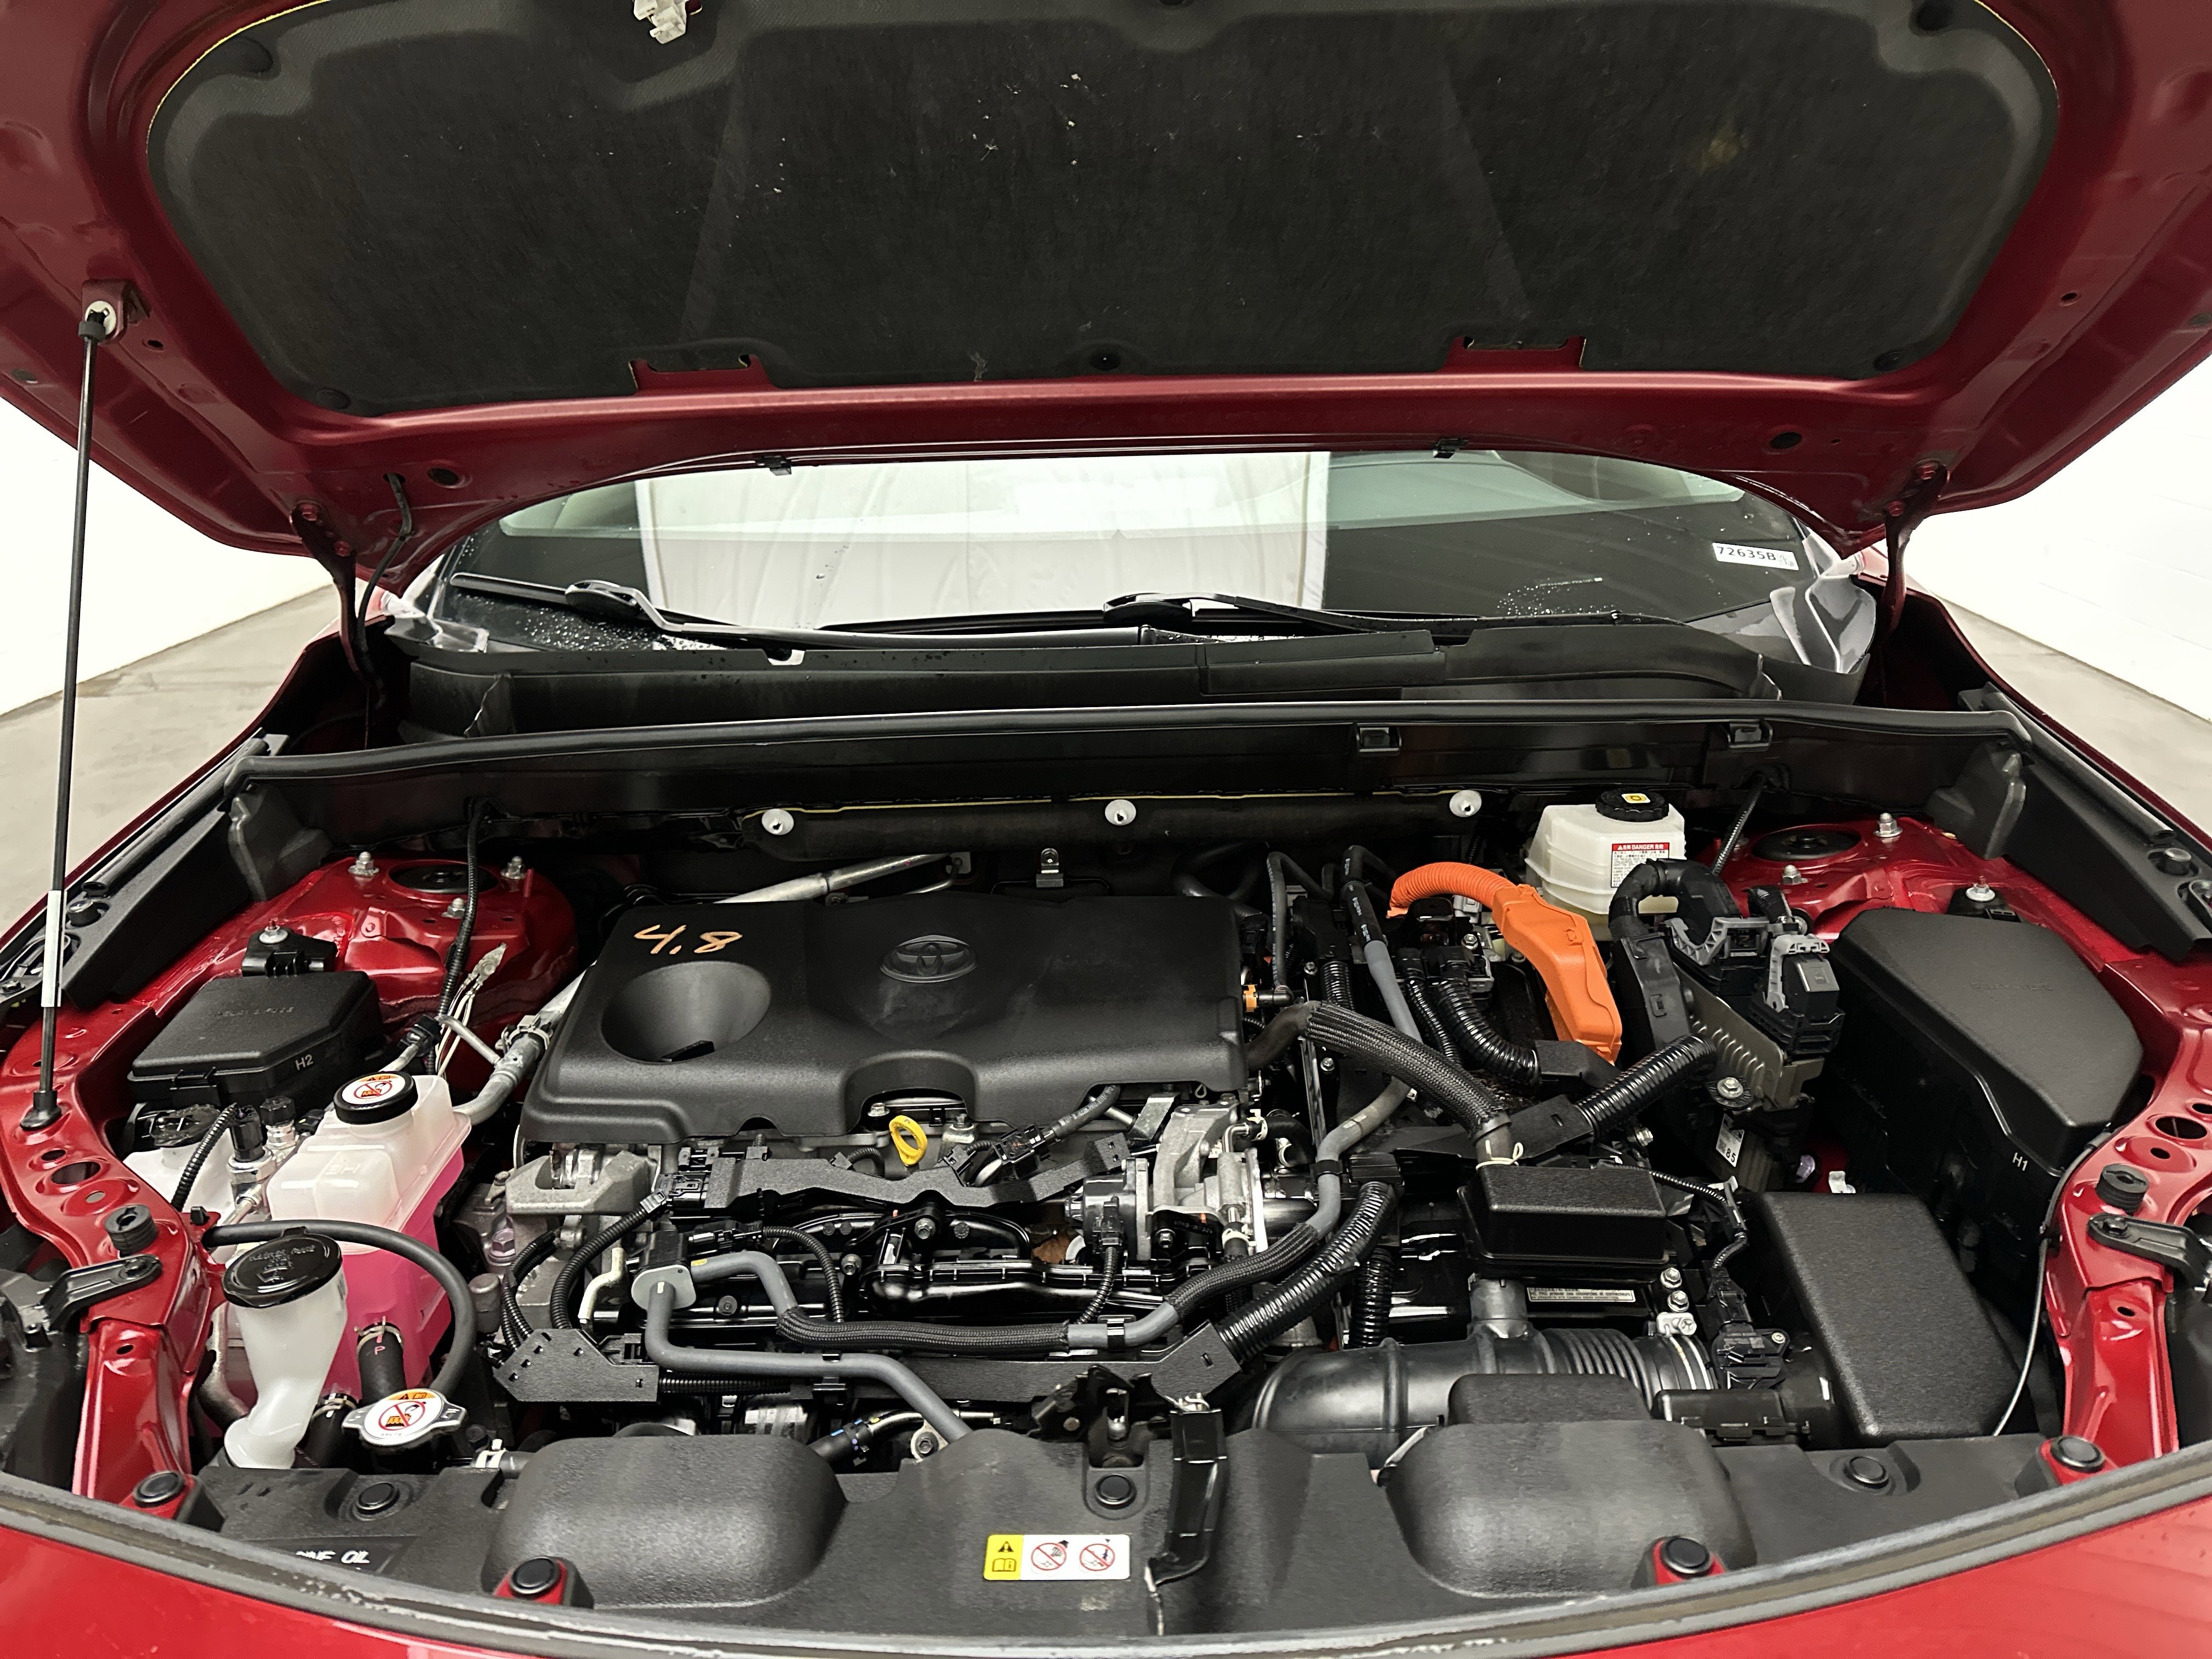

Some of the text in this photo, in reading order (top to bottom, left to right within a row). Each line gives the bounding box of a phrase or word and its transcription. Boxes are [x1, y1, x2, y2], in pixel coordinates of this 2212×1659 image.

[1716, 546, 1776, 561] 72635B
[295, 1054, 313, 1070] H2
[1726, 1148, 1736, 1163] 85
[2012, 1152, 2028, 1171] H1
[374, 1345, 386, 1356] P
[341, 1550, 371, 1564] OIL
